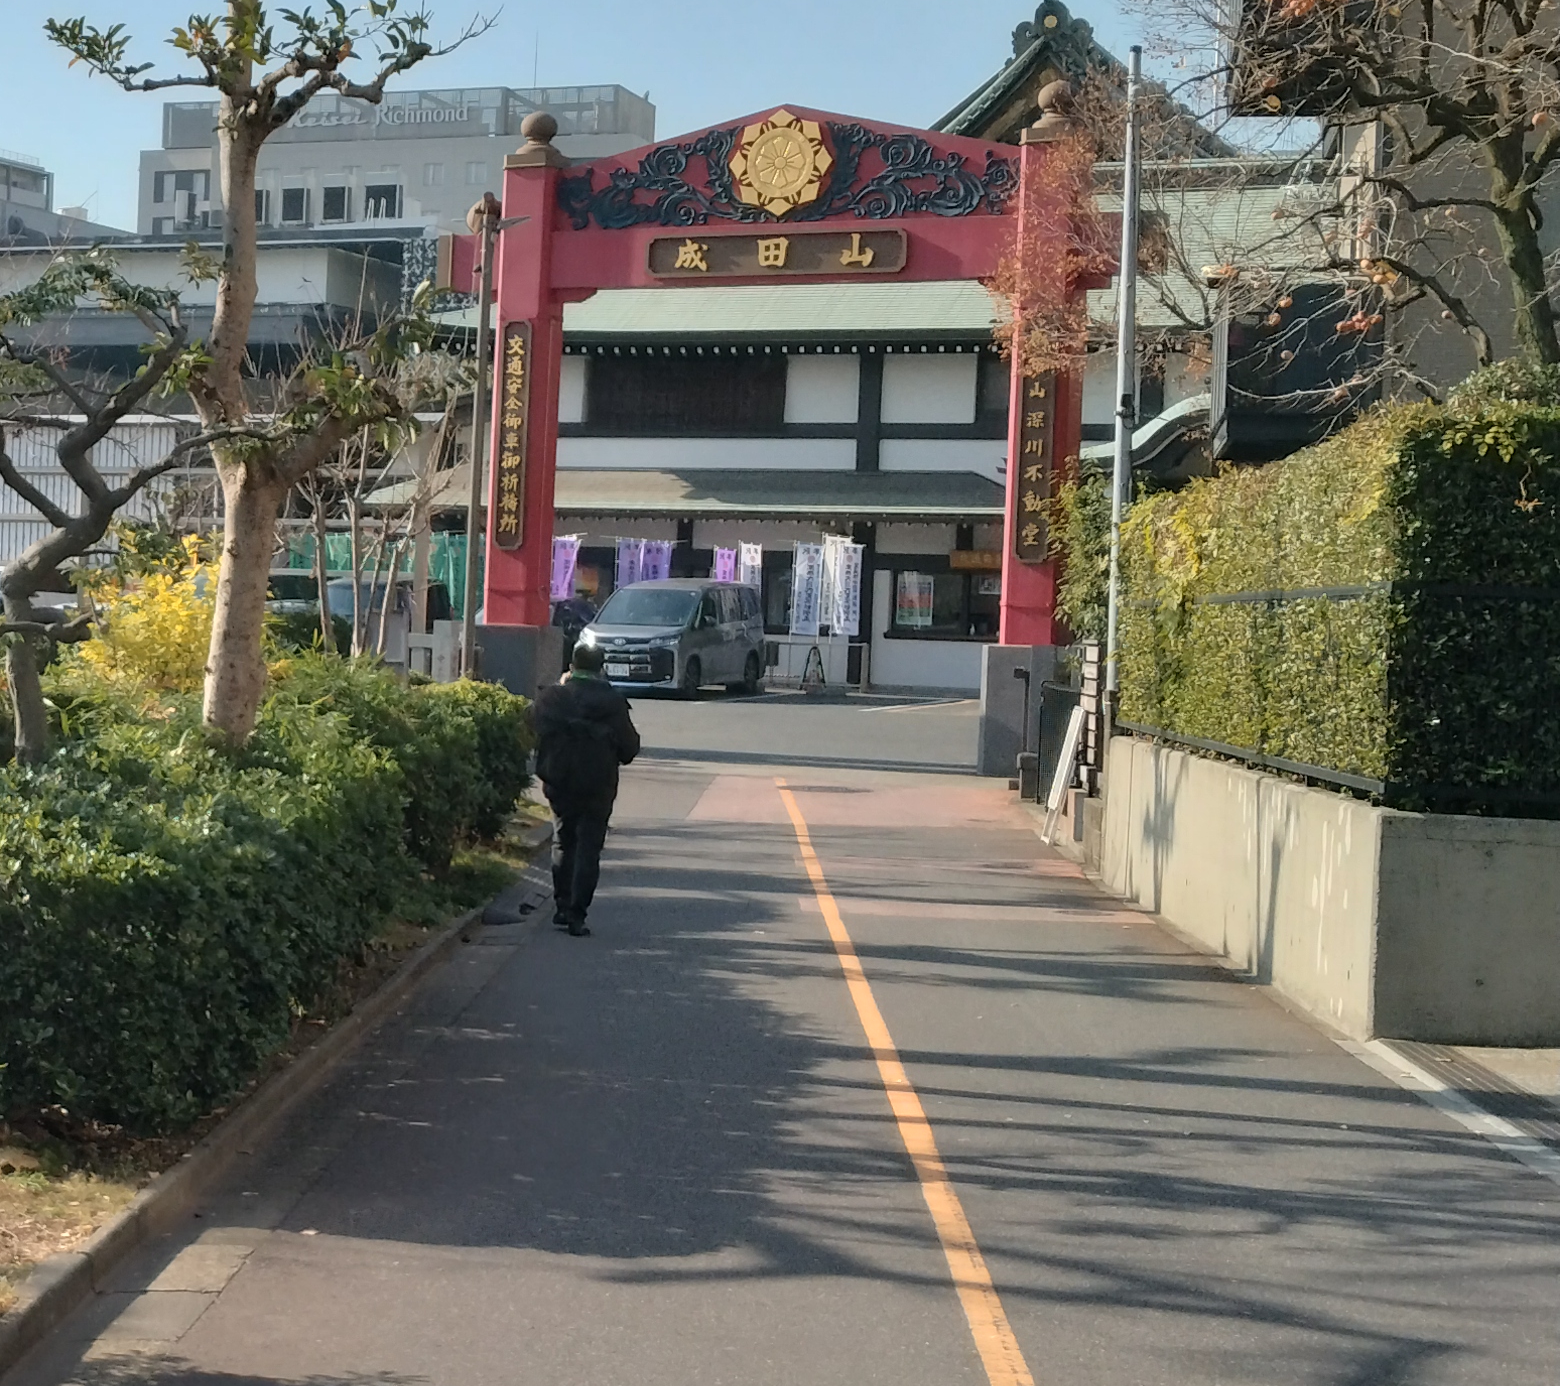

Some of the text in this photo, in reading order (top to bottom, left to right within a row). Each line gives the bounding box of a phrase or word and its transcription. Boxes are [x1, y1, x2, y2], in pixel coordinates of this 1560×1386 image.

[287, 104, 469, 129] Keisei Richmond
[674, 233, 875, 271] 成田山
[1021, 381, 1047, 547] 山深川不動堂
